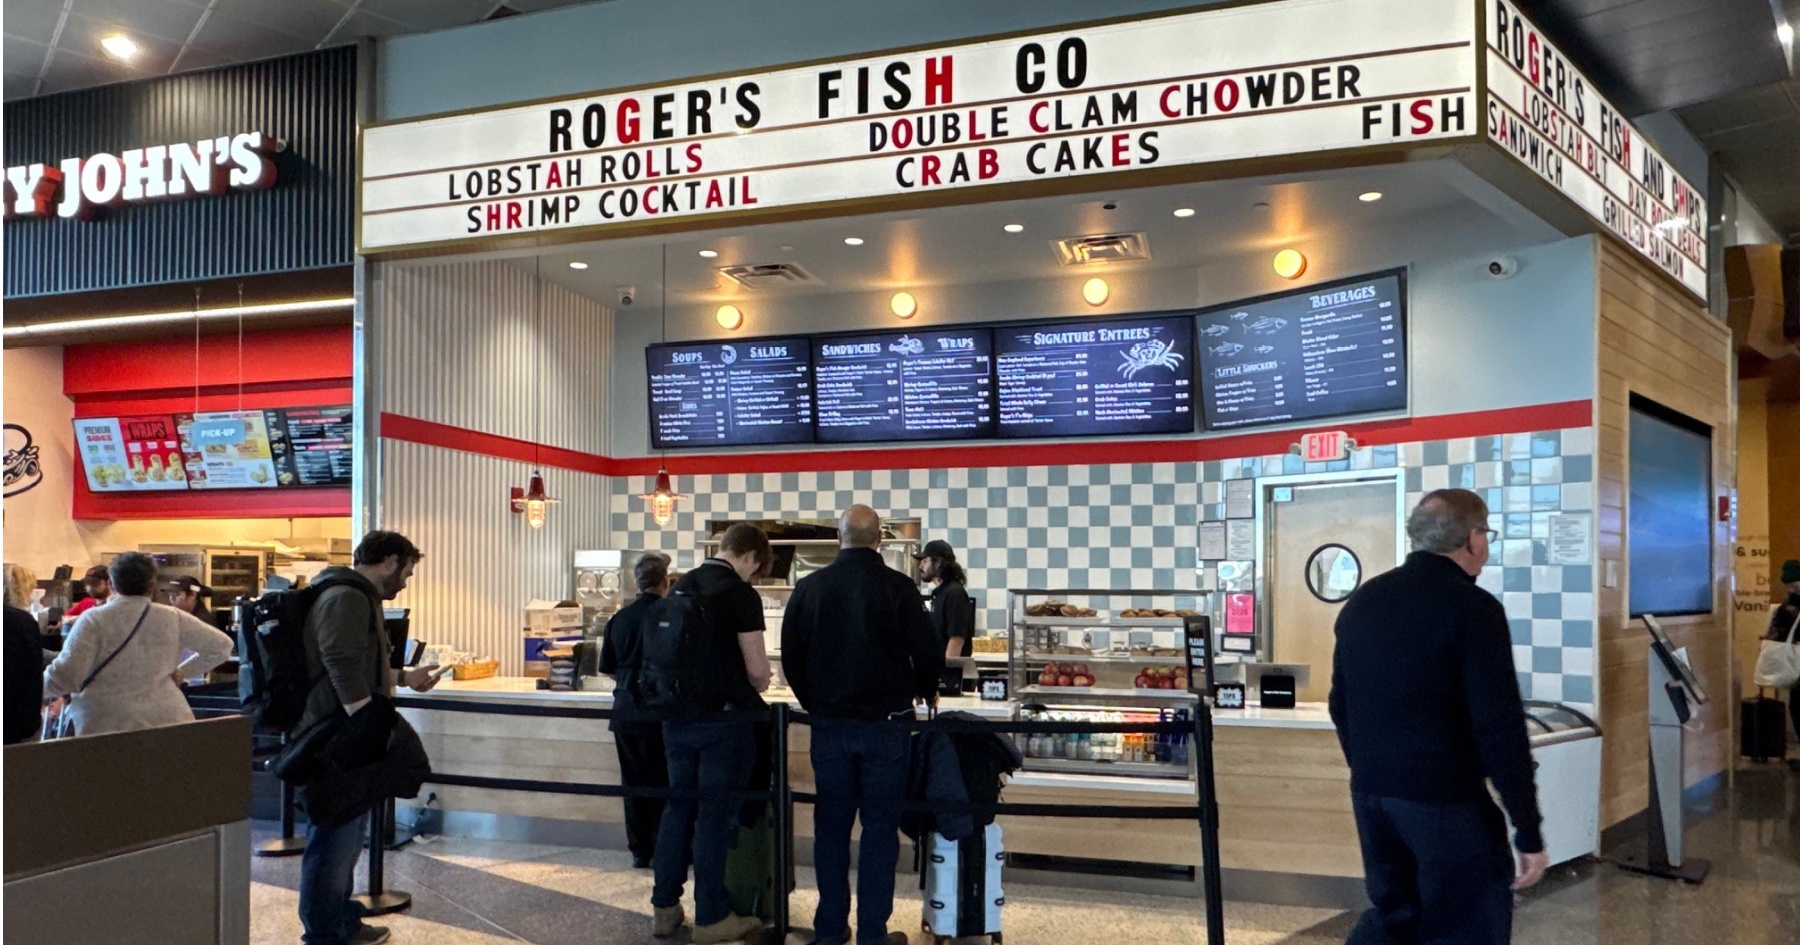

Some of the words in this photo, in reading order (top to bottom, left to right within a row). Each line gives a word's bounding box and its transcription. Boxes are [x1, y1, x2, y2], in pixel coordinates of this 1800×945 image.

[550, 81, 761, 152] ROGER'S
[818, 55, 953, 119] FISH
[1016, 37, 1087, 94] CO
[869, 106, 1008, 152] DOUBLE
[1029, 90, 1138, 133] CLAM
[1159, 64, 1361, 118] CHOWDER
[1362, 96, 1464, 139] FISH
[1497, 0, 1584, 127] ROGER'S
[1600, 102, 1631, 172] FISH
[1643, 148, 1664, 200] AND
[1672, 174, 1700, 234] CHIPS
[1523, 85, 1582, 164] LOBSTAH
[1587, 141, 1607, 185] BLT
[896, 149, 1000, 188] CRAB
[1026, 131, 1160, 175] CAKES
[1489, 100, 1563, 188] SANDWICH
[58, 131, 262, 218] JOHN'S
[449, 158, 582, 200] LOBSTAH
[601, 143, 702, 184] ROLLS
[467, 195, 581, 233] SHRIMP
[599, 176, 758, 219] COCKTAIL
[1629, 180, 1647, 219] DAY
[1649, 231, 1684, 281] SALMON
[1309, 285, 1376, 308] BEVERAGES
[750, 347, 787, 358] SALADS
[822, 343, 881, 356] SANDWICHES
[937, 337, 974, 348] WRAPS
[1034, 330, 1095, 345] SIGNATURE
[1098, 327, 1150, 342] ENTREES
[672, 352, 703, 363] SOUPS
[1217, 366, 1241, 377] LITTLE
[130, 421, 166, 438] WRAPS
[200, 428, 236, 438] PICK-UP
[1309, 433, 1339, 459] EXIT
